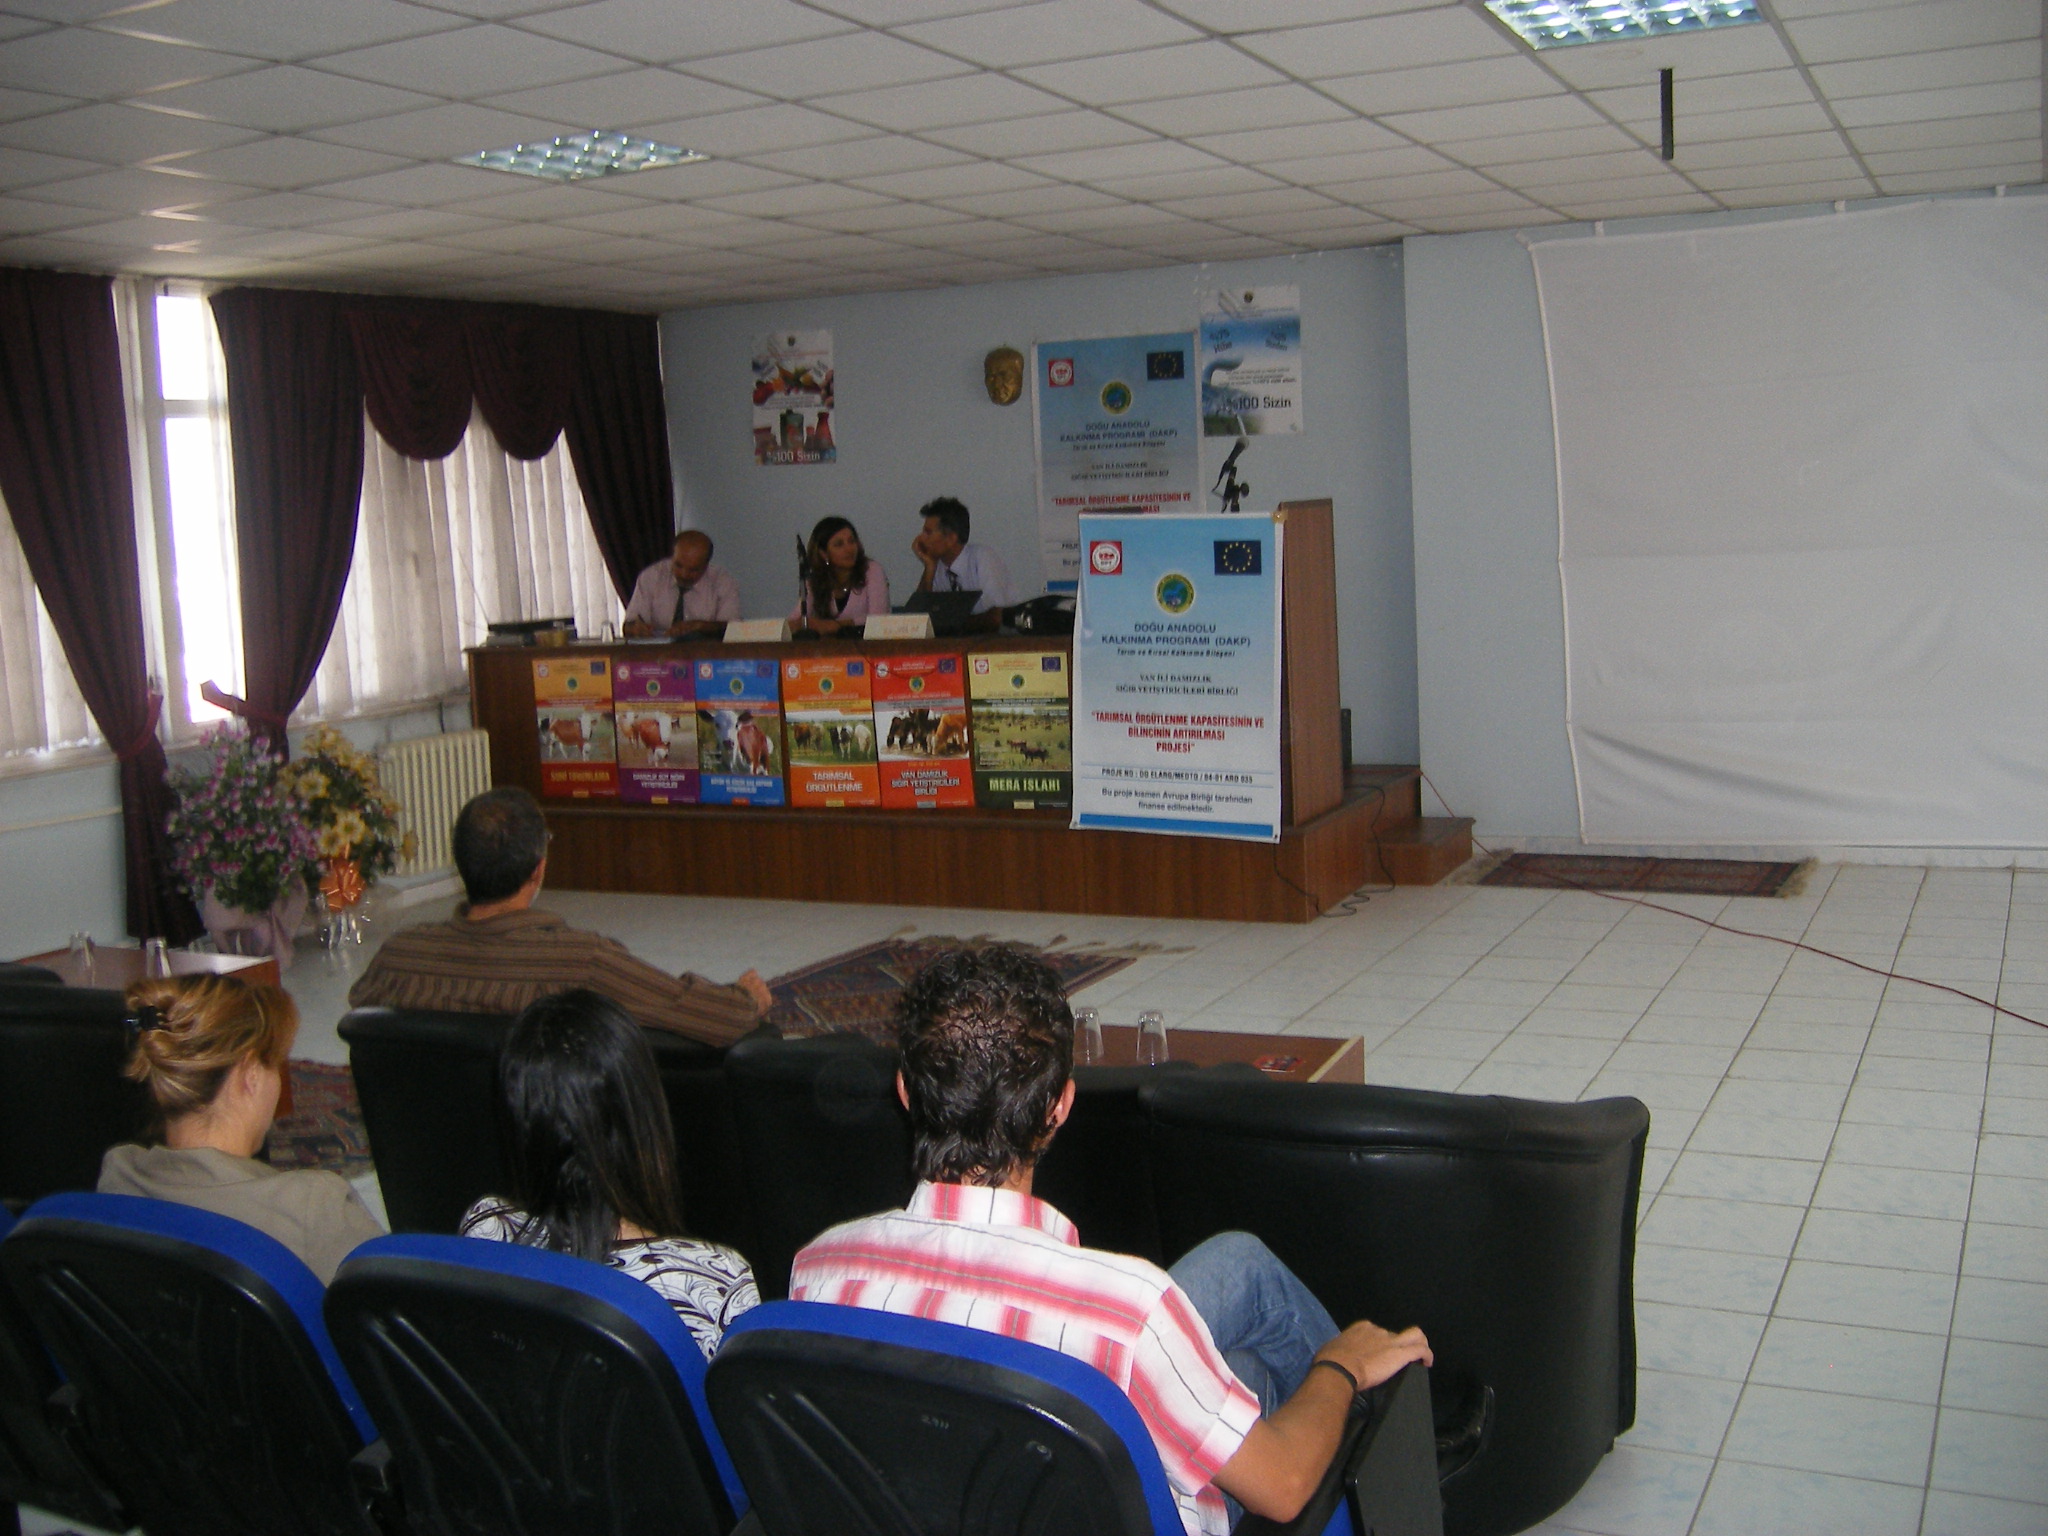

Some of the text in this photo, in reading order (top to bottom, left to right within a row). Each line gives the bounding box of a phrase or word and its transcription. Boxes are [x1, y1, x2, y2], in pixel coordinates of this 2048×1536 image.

[1263, 395, 1291, 409] Sizin
[1110, 420, 1150, 430] ANADOLU
[1060, 428, 1178, 442] KALKINMA PROGRAMI (DAKP)
[1134, 621, 1216, 633] DOĞU ANADOLU
[1101, 635, 1251, 647] KALKINMA PROGRAMI (DAKP)
[1171, 649, 1204, 657] Kalkınma
[1135, 712, 1188, 726] ÖRGÜTLENME
[1190, 713, 1252, 728] KAPASİTESİNİN
[1254, 717, 1265, 729] VE
[1128, 725, 1225, 741] BİLİNCİNİN ARTIRILMASI
[812, 771, 854, 782] TARIMSAL
[901, 769, 948, 780] VAN DAMIZLIK
[1102, 768, 1123, 777] PROJE
[1124, 769, 1134, 778] NO
[989, 778, 1060, 791] MERA ISLAHI
[1102, 788, 1253, 804] Bu proje kısmen Avrupa Birliği tarafından
[1138, 801, 1165, 810] finanse
